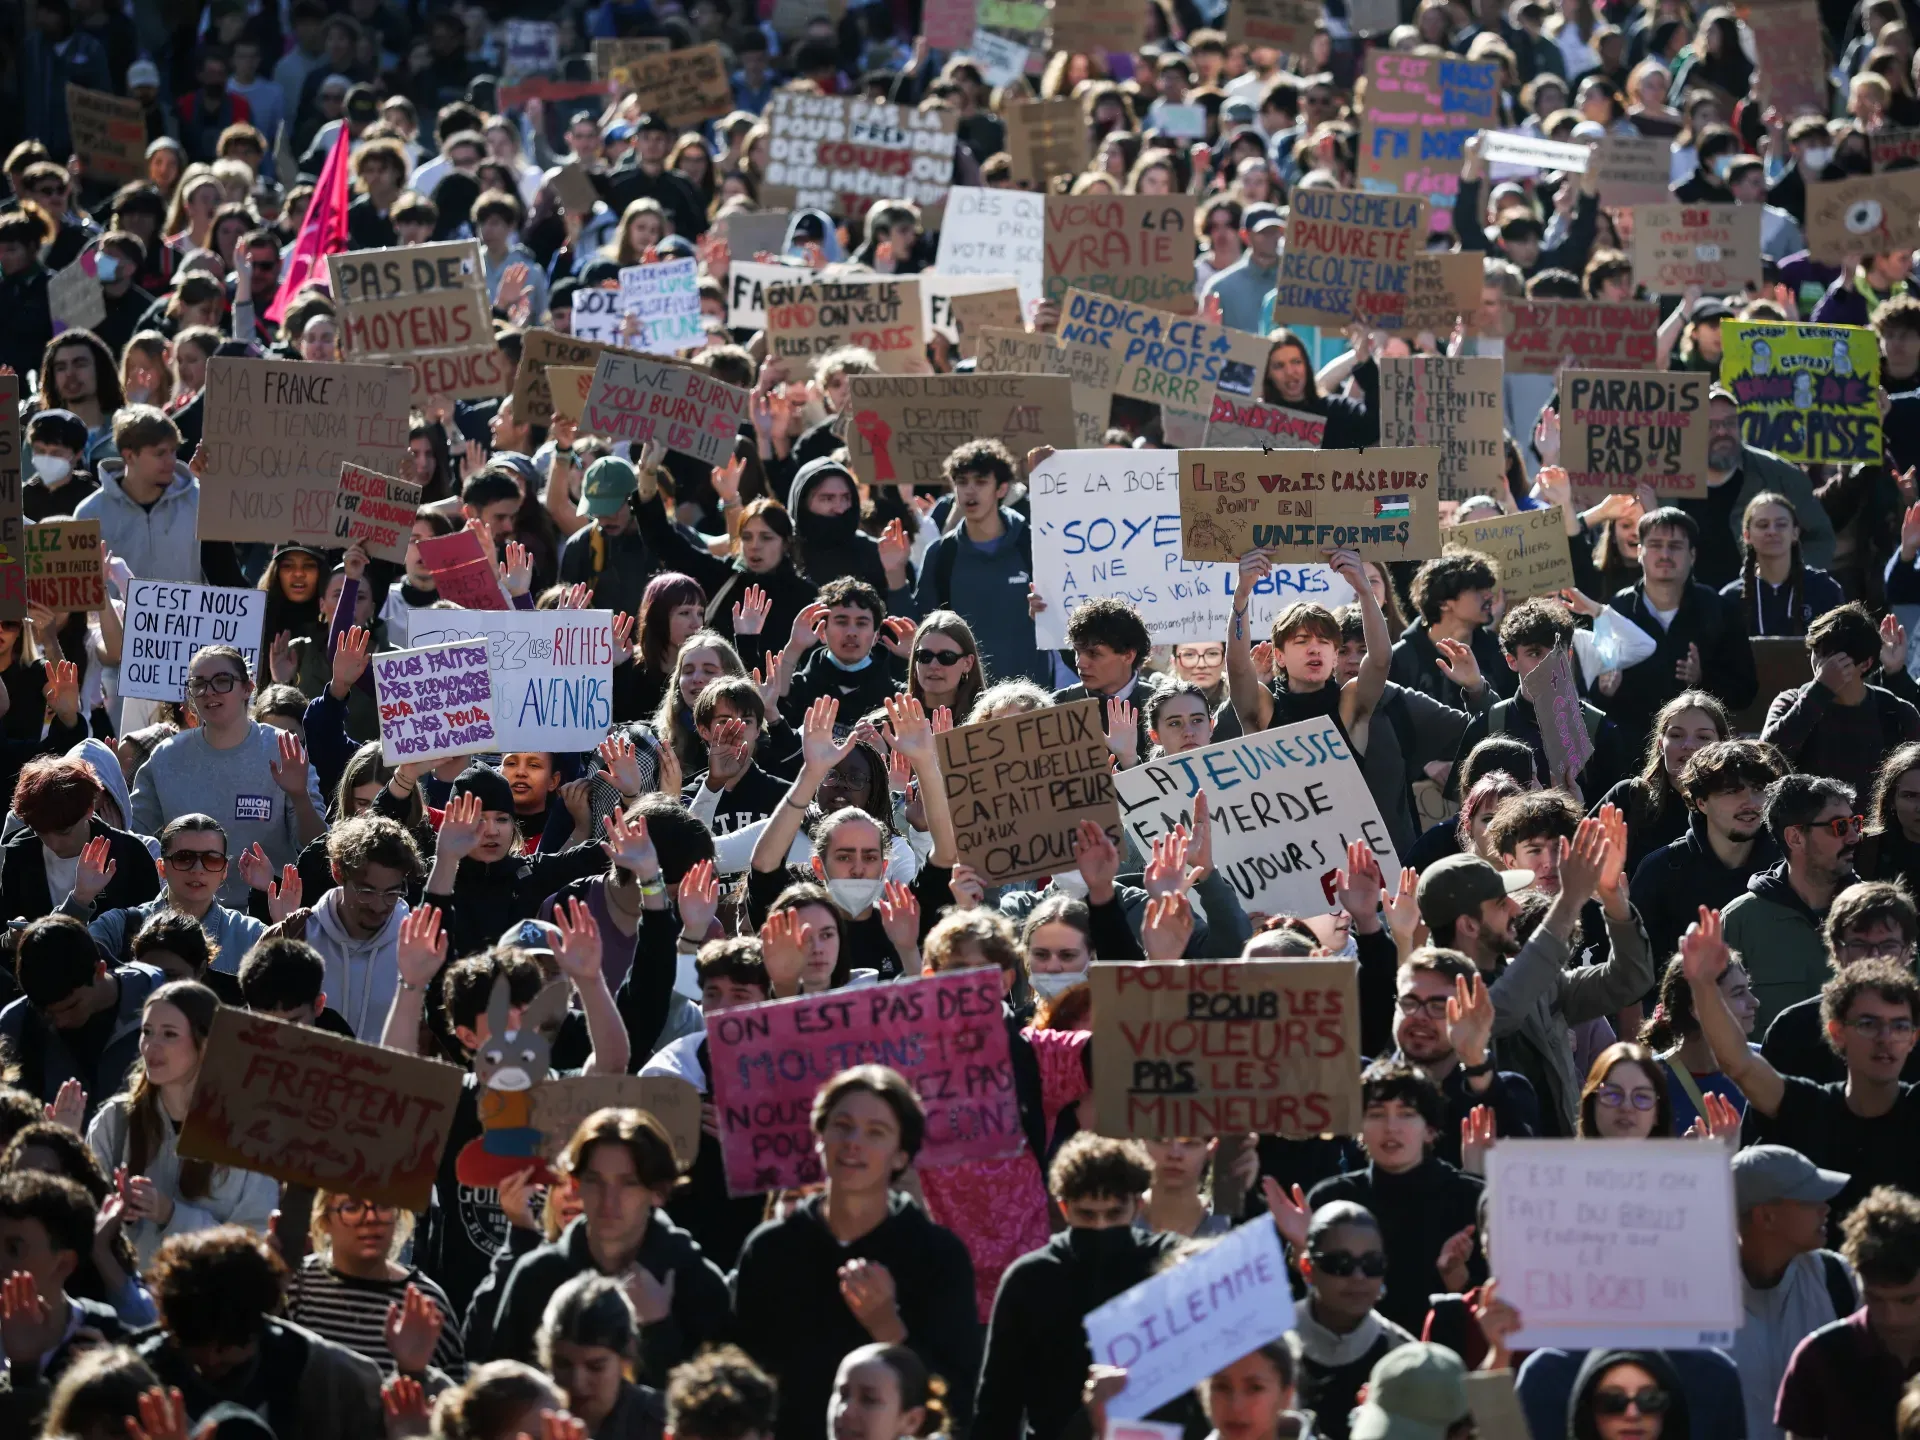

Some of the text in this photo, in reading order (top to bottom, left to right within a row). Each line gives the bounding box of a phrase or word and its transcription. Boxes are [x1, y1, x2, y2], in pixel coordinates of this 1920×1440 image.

[1141, 207, 1185, 231] LA
[1294, 190, 1417, 228] QUI LA
[1293, 219, 1413, 262] PAUVRETÉ
[337, 256, 464, 301] PAS DE
[1375, 263, 1412, 294] UNE
[818, 304, 850, 328] ON
[850, 301, 902, 323] VEUT
[1277, 283, 1352, 316] JEUNESSE
[344, 303, 472, 352] MOYENS
[1061, 322, 1221, 382] NOS PROFS
[210, 366, 252, 405] MA
[264, 371, 335, 406] FRANCE
[603, 359, 745, 415] IF WE BURN
[852, 377, 919, 398] QUAND
[599, 382, 707, 429] YOU BURN
[903, 407, 982, 430] DEVIENT
[1573, 410, 1691, 428] POUR LES UNS
[206, 407, 253, 438] LEUR
[590, 406, 695, 450] WITH US
[1587, 424, 1682, 451] PAS UN
[1039, 470, 1111, 496] DE LA
[1190, 462, 1246, 494] LES
[1257, 472, 1326, 494] VRAIS
[1569, 473, 1611, 489] POUR
[229, 488, 284, 519] NOUS
[1215, 496, 1313, 518] SONT EN
[335, 515, 350, 538] LA
[1252, 520, 1410, 550] UNIFORMES
[1530, 511, 1563, 530] C'EST
[68, 534, 98, 550] VOS
[1062, 558, 1128, 593] À NE
[135, 583, 250, 618] C'EST NOUS
[134, 611, 239, 643] ON FAIT DU
[132, 636, 184, 662] BRUIT
[377, 652, 424, 682] VOUS
[424, 644, 490, 675] FAITES
[529, 637, 553, 660] LES
[128, 662, 162, 687] QUE
[378, 680, 413, 703] DES
[379, 700, 415, 722] SUR
[414, 693, 445, 715] NOS
[382, 705, 491, 741] ET PAS POUR
[394, 722, 495, 756] NOS AVENIRS
[944, 706, 1095, 770] LES FEUX
[944, 745, 1108, 799] DE POUBELLE
[1114, 729, 1351, 817] LA JEUNESSE
[237, 798, 271, 809] UNION
[1048, 772, 1116, 810] PEUR
[237, 807, 270, 817] PIRATE
[956, 820, 1019, 854] QU'AUX
[1115, 964, 1244, 995] POLICE
[717, 983, 997, 1045] ON EST PAS DES
[1284, 987, 1344, 1017] LES
[1118, 1019, 1346, 1062] VIOLEURS
[242, 1053, 446, 1132] FRAPPENT
[963, 1058, 1016, 1097] PAS
[1131, 1060, 1281, 1093] PAS LES
[1127, 1091, 1333, 1136] MINEURS
[1503, 1162, 1568, 1188] C'EST
[1585, 1168, 1648, 1192] NOUS
[1507, 1196, 1688, 1231] FAIT DU BRUIT
[1524, 1270, 1573, 1309] EN
[1105, 1252, 1274, 1370] DILEMME
